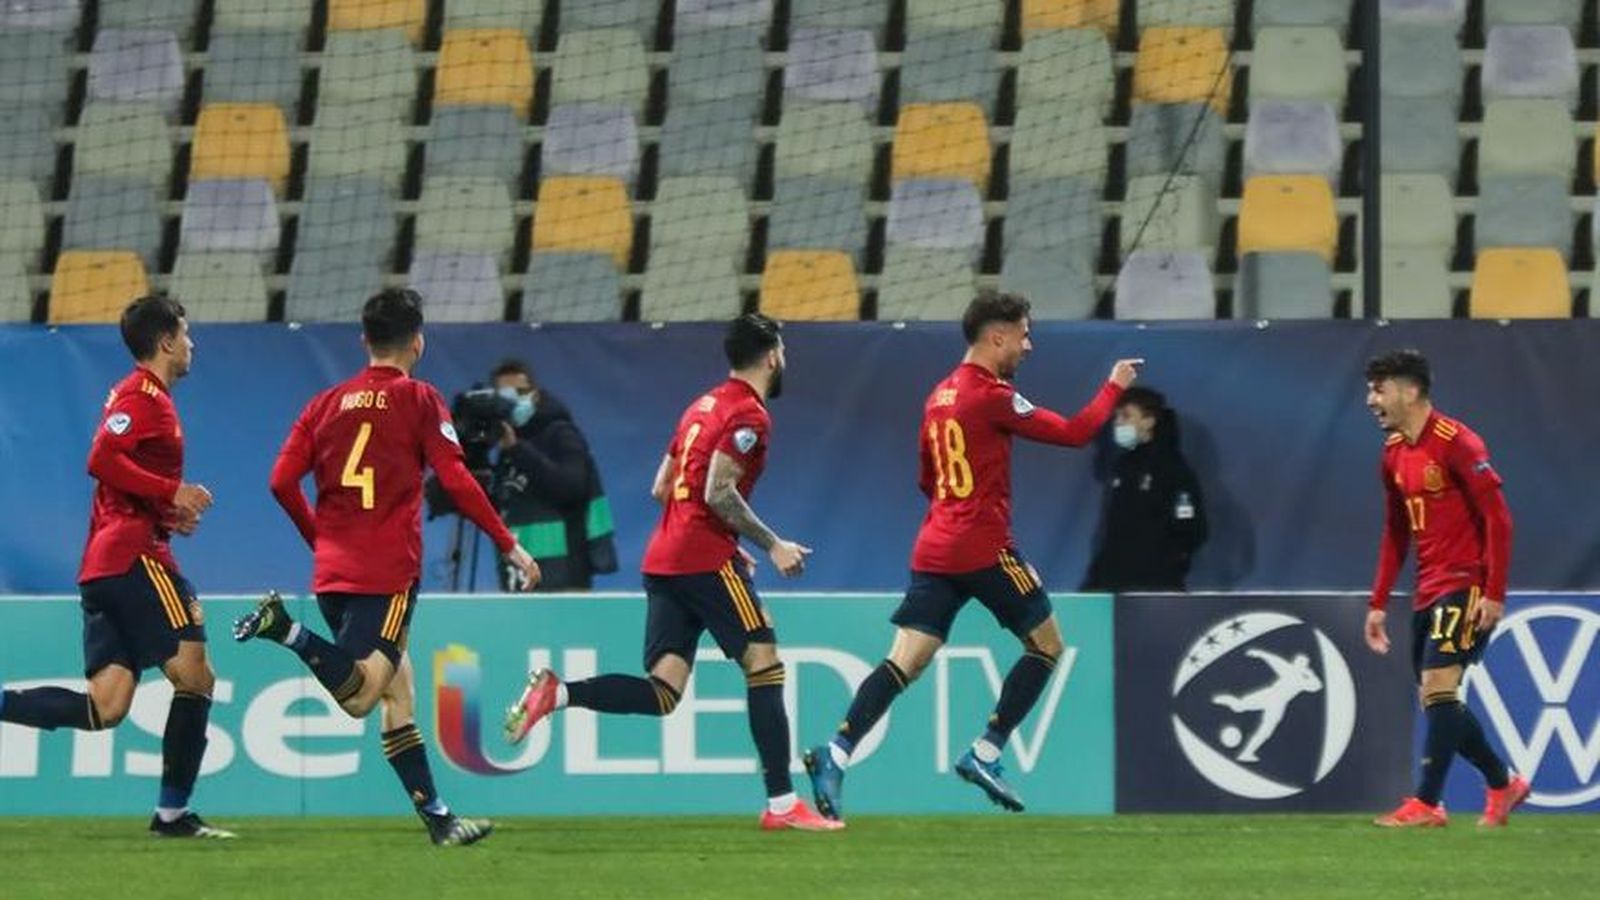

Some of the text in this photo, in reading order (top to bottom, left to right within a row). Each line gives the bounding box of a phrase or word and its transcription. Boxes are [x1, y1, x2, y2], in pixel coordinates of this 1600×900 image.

[341, 421, 375, 510] 4
[928, 418, 974, 499] 18
[1406, 496, 1425, 531] 17
[1430, 605, 1462, 639] 17
[432, 643, 1078, 777] ULED TV
